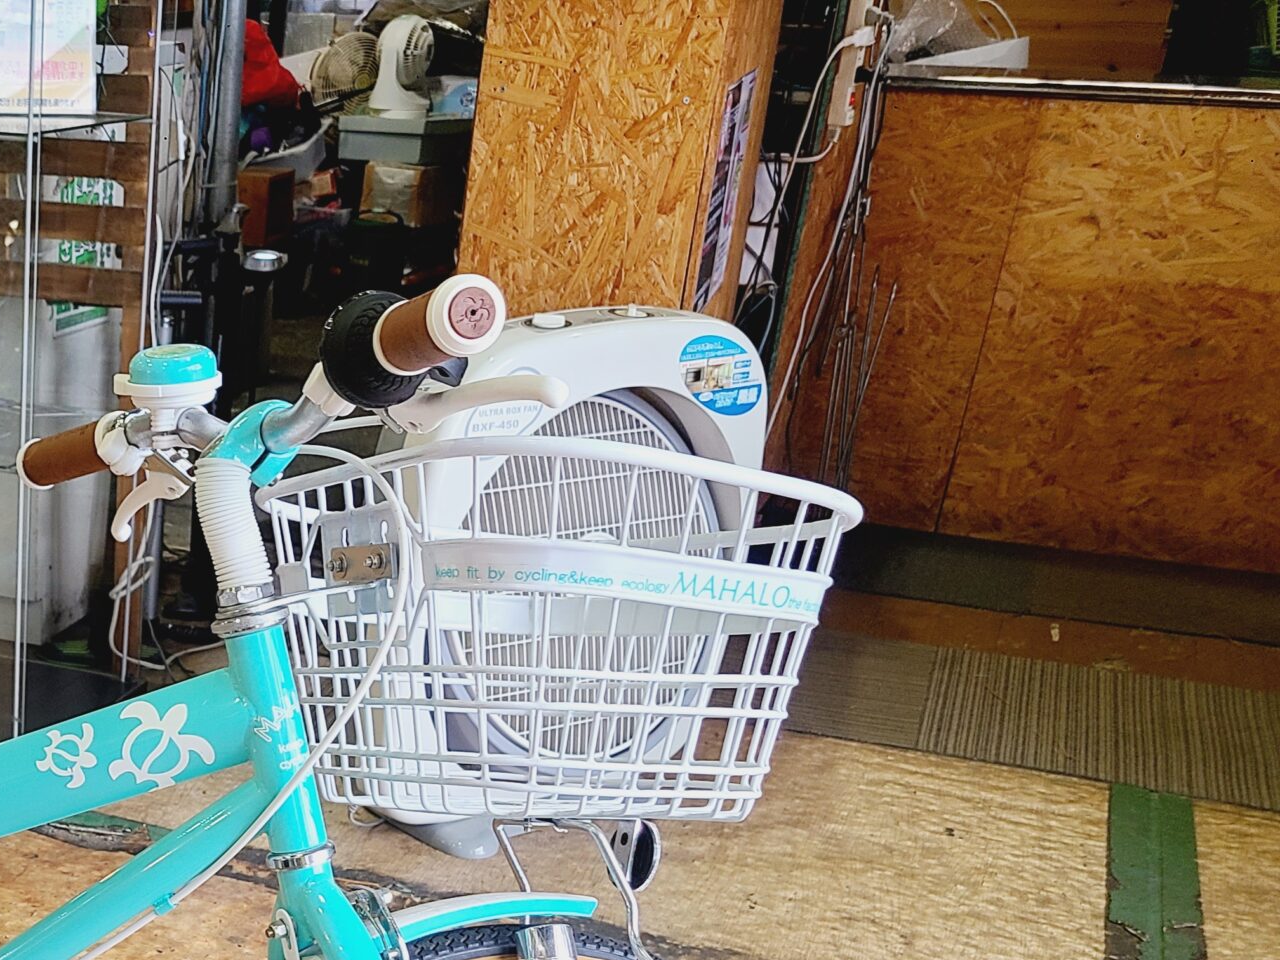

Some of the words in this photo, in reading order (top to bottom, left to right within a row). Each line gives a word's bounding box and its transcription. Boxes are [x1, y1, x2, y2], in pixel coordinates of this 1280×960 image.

[479, 407, 504, 418] ULTRA
[506, 405, 521, 416] BOX
[523, 402, 539, 412] FAN
[472, 420, 519, 432] BXF-450
[435, 563, 460, 578] keep
[467, 565, 482, 579] fit
[487, 566, 506, 581] by
[514, 568, 614, 587] cycling&keep
[621, 578, 670, 594] ecology
[670, 571, 791, 608] MAHALO
